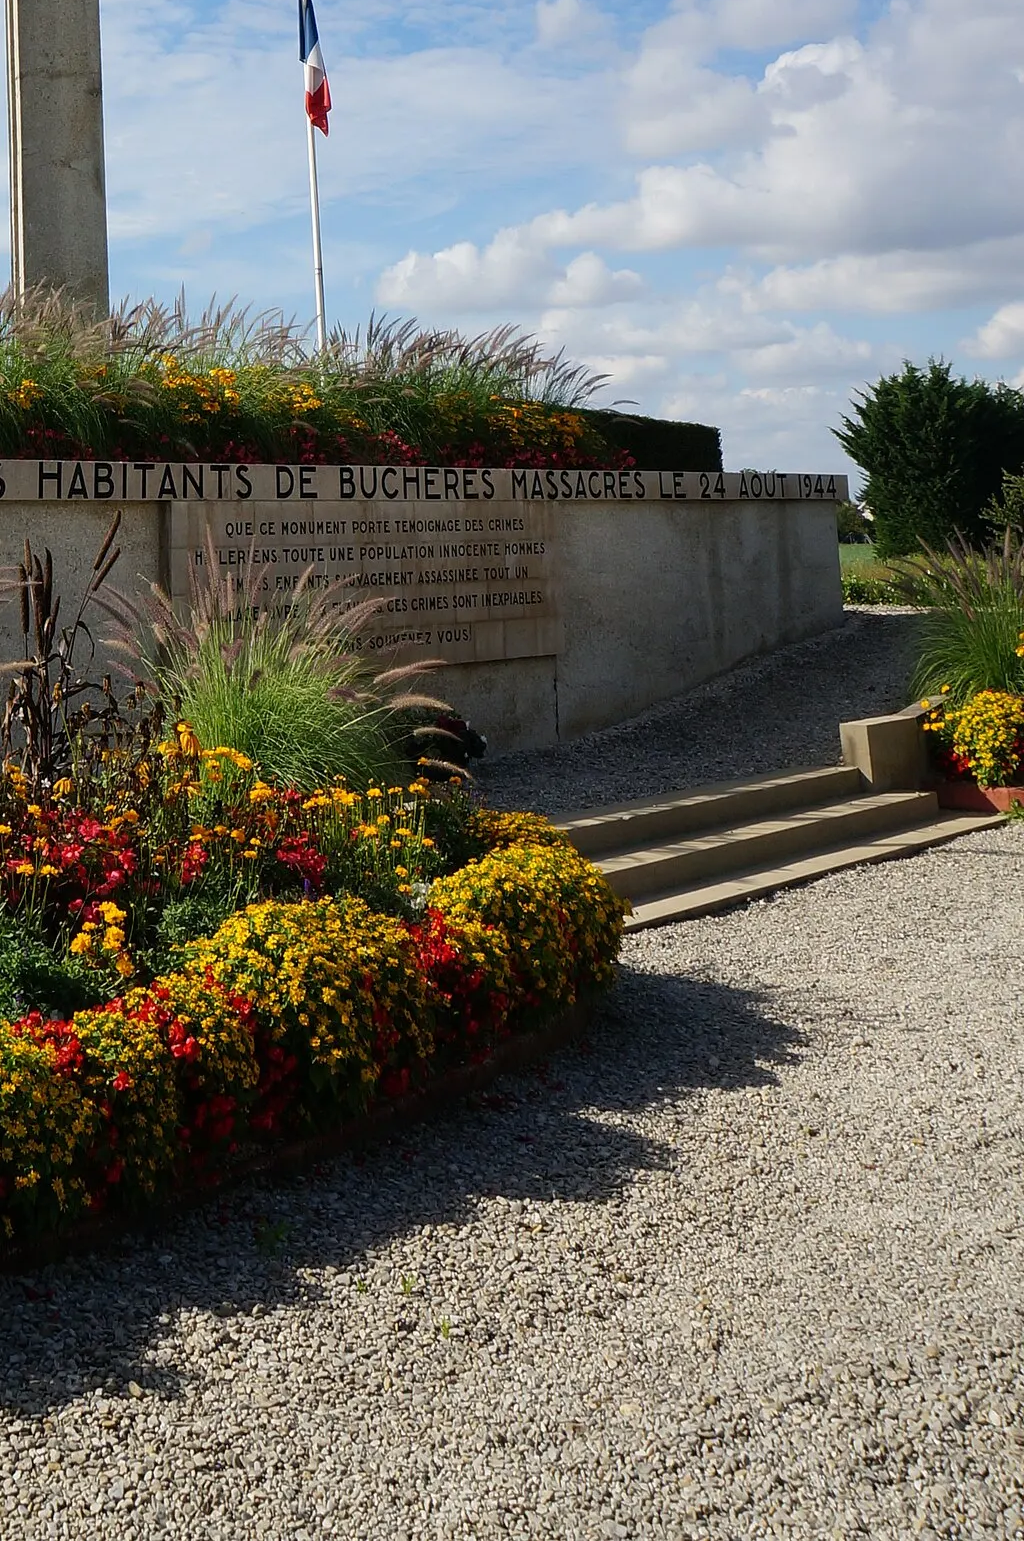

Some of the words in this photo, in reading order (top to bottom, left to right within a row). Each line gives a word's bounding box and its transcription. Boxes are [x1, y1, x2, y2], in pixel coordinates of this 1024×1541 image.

[38, 461, 253, 500] HABITANTS
[276, 465, 318, 500] DE
[339, 466, 495, 500] BUCHERES
[511, 470, 646, 500] MASSACRES
[659, 472, 687, 499] LE
[699, 472, 726, 499] 24
[739, 473, 787, 498] AOUT
[798, 474, 837, 498] 1944
[225, 522, 253, 538] QUE
[259, 522, 276, 536] CE
[281, 521, 347, 536] MONUMENT
[351, 520, 390, 534] PORTE
[394, 519, 462, 533] TEMOIGNAGE
[465, 519, 484, 532] DES
[488, 518, 524, 532] CRIMES
[283, 548, 325, 564] TOUTE
[329, 547, 354, 561] UNE
[359, 546, 434, 561] POPULATION
[439, 543, 500, 558] INNOCENTE
[275, 574, 329, 590] ENFNTS
[335, 571, 414, 587] SUVAGEMENT
[417, 568, 478, 584] ASSASSINEE
[483, 567, 511, 580] TOUT
[515, 566, 528, 579] UN
[387, 598, 407, 613] CES
[411, 597, 448, 611] CRIMES
[452, 594, 478, 609] SONT
